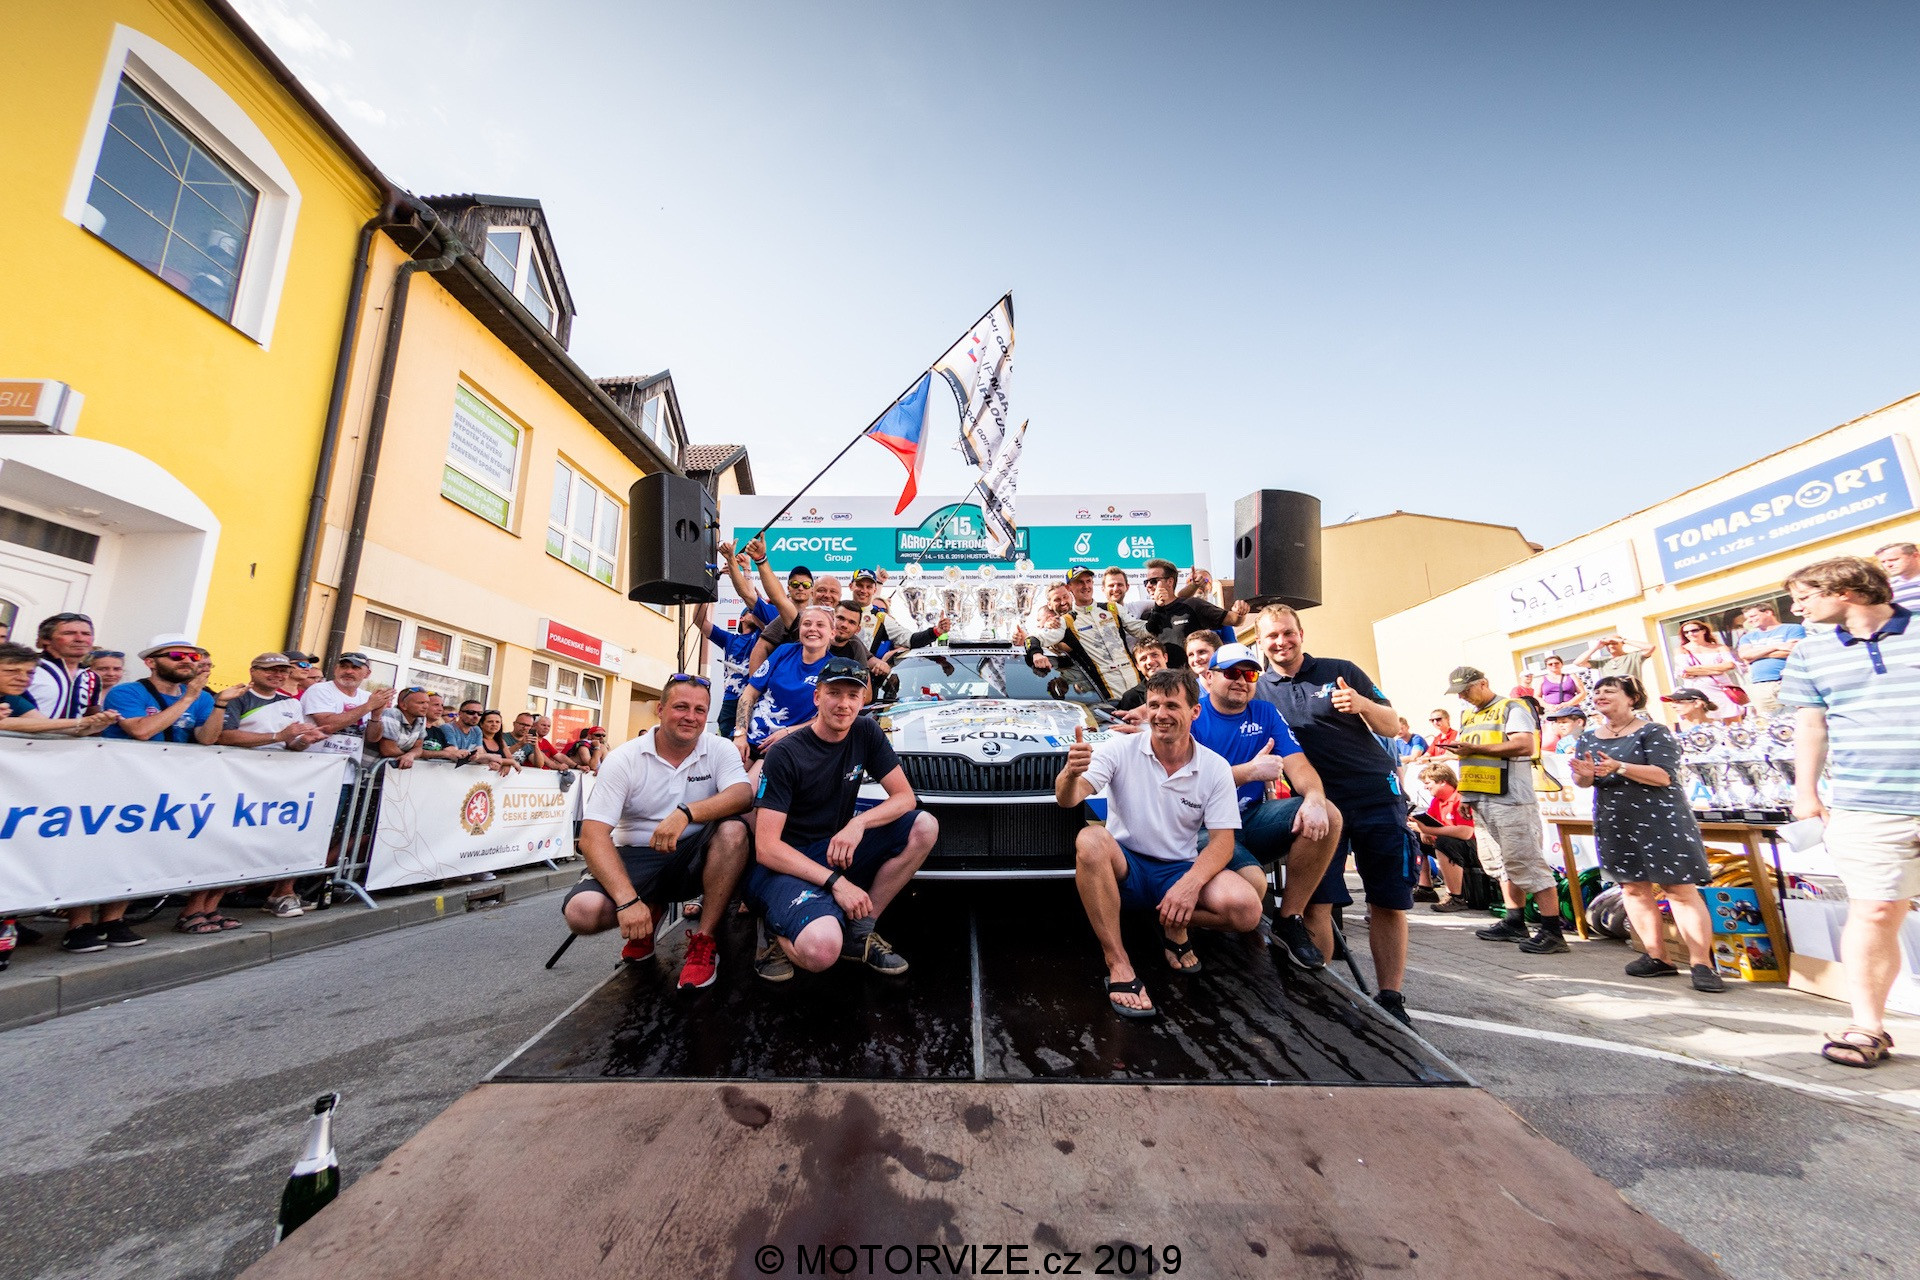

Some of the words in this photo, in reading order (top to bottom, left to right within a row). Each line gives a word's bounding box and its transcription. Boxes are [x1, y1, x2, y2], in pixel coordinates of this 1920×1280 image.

[951, 516, 977, 535] 15.
[1674, 555, 1708, 570] KOLA
[1720, 538, 1756, 556] LYŽE
[1768, 492, 1889, 540] SNOWBOARDY
[771, 537, 857, 551] AGROTEC
[900, 533, 943, 549] AGROTEC
[945, 538, 988, 549] PETRONA
[1131, 536, 1154, 546] EAA
[824, 553, 853, 563] Group
[1131, 549, 1152, 558] OIL
[549, 633, 584, 650] PORADENSKÉ
[585, 645, 600, 656] MÍSTO
[502, 792, 566, 808] AUTOKLUB
[0, 793, 216, 839] ravský
[232, 792, 315, 832] kraj
[502, 810, 527, 821] ČESKÉ
[530, 809, 565, 820] REPUBLIKY
[459, 844, 520, 859] www.autoklub.cz
